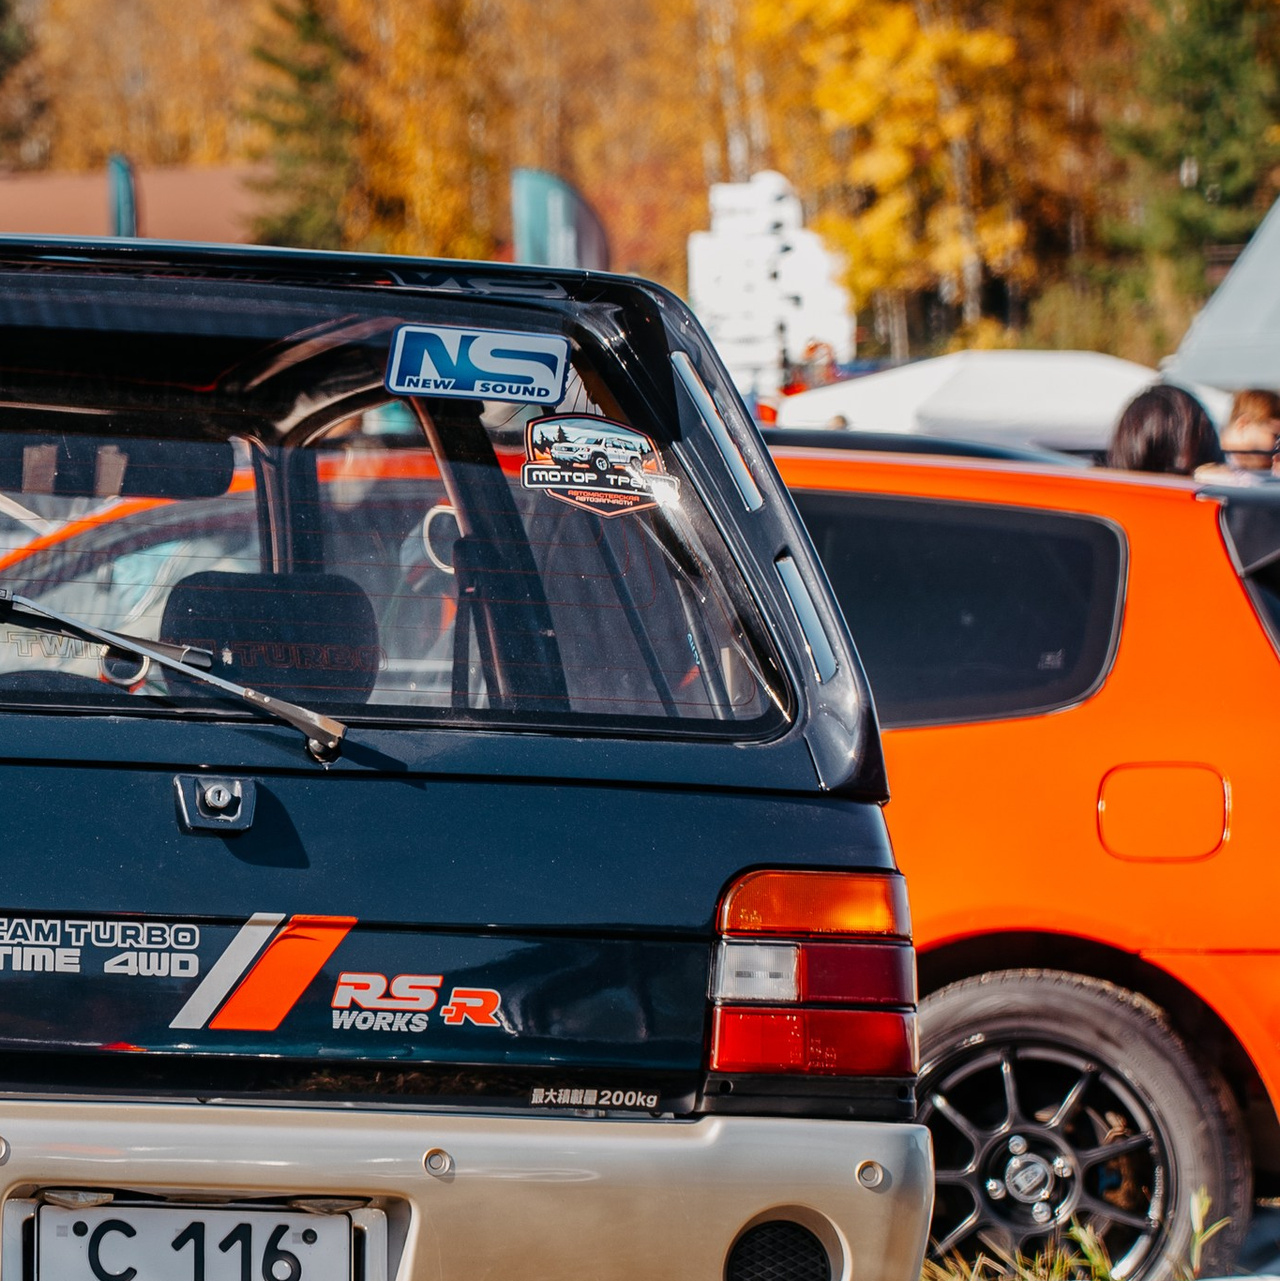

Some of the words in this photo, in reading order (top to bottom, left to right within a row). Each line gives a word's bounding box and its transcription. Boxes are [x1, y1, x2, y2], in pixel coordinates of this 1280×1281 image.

[395, 330, 559, 391] NS
[406, 376, 455, 390] NEW
[479, 382, 550, 398] SOUND
[532, 471, 598, 483] МОТОР
[230, 641, 389, 671] TURBO
[65, 920, 200, 950] TURBO
[103, 951, 200, 979] 4WD
[331, 971, 444, 1012] RS
[332, 1009, 429, 1033] WORKS
